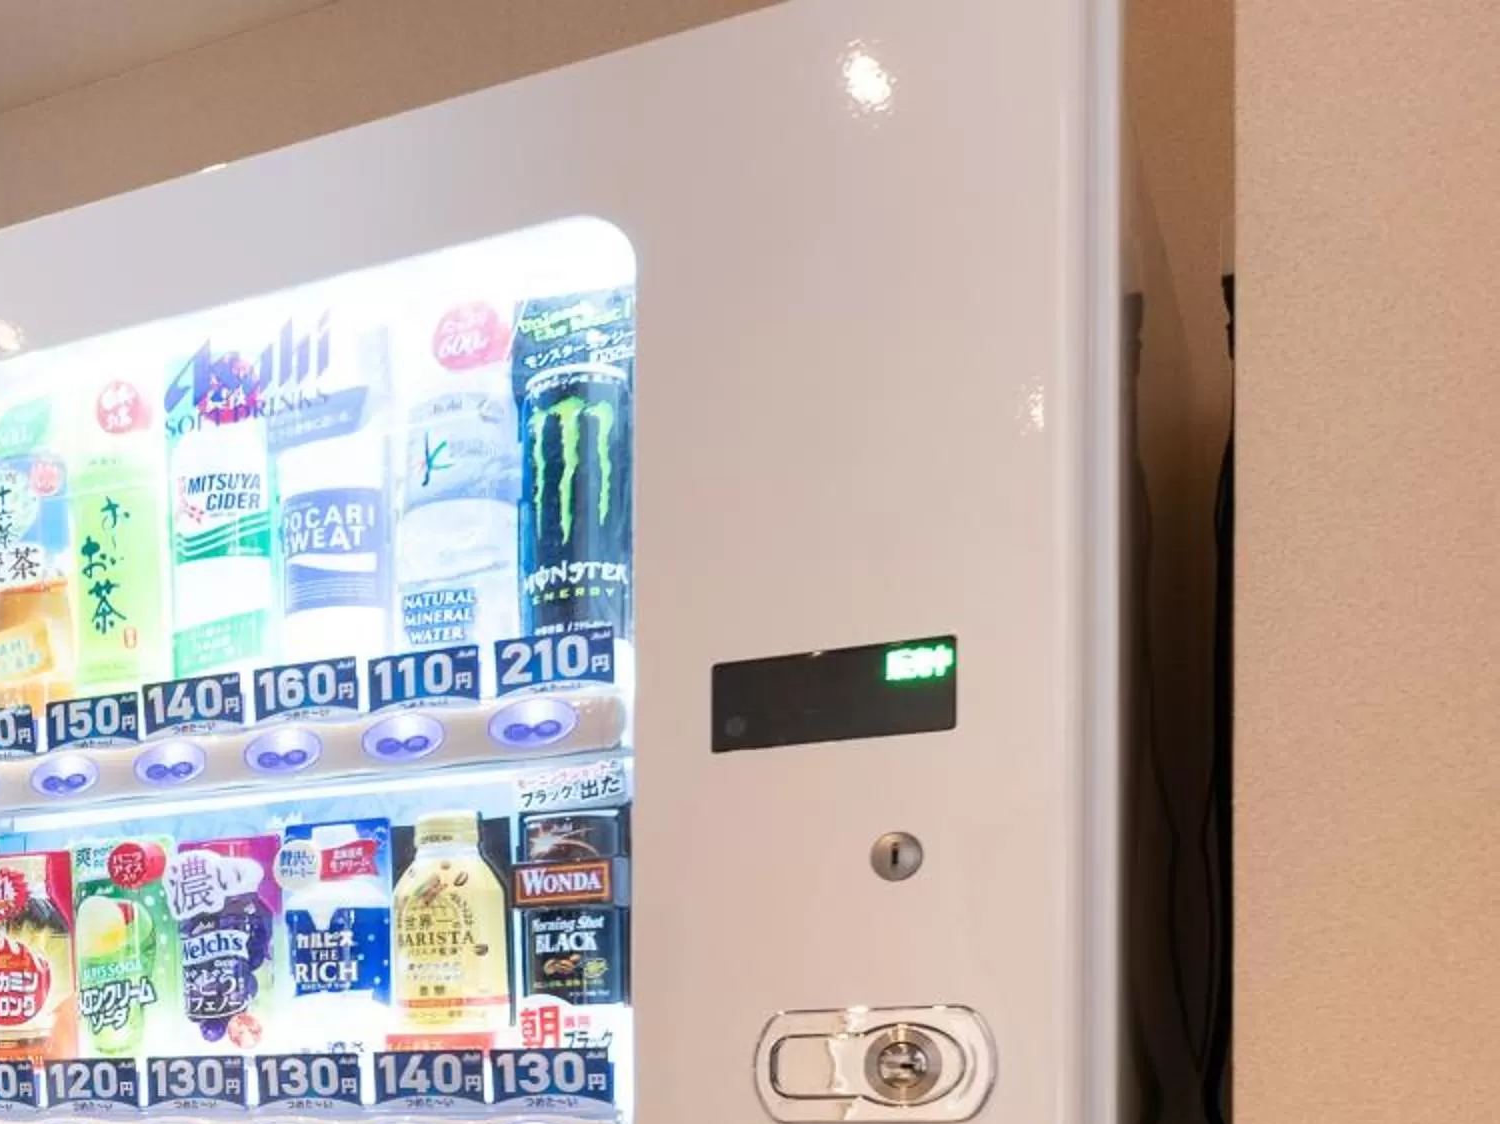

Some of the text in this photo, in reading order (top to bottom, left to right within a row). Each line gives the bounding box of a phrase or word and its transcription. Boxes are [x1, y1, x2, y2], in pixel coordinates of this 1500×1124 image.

[187, 472, 261, 496] MITSUYA
[205, 492, 261, 511] CIDER
[403, 588, 477, 609] NATURAL
[404, 607, 472, 626] MINERAL
[408, 626, 464, 644] WATER
[169, 857, 242, 914] 濃い
[520, 866, 603, 897] WONDA
[311, 947, 339, 961] THE
[535, 931, 599, 953] BLACK
[295, 961, 359, 983] RICH
[50, 1061, 135, 1098] 120円
[150, 1058, 242, 1098] 130円
[259, 1057, 358, 1098] 130円
[377, 1053, 483, 1095] 140円
[493, 1051, 607, 1095] 130円
